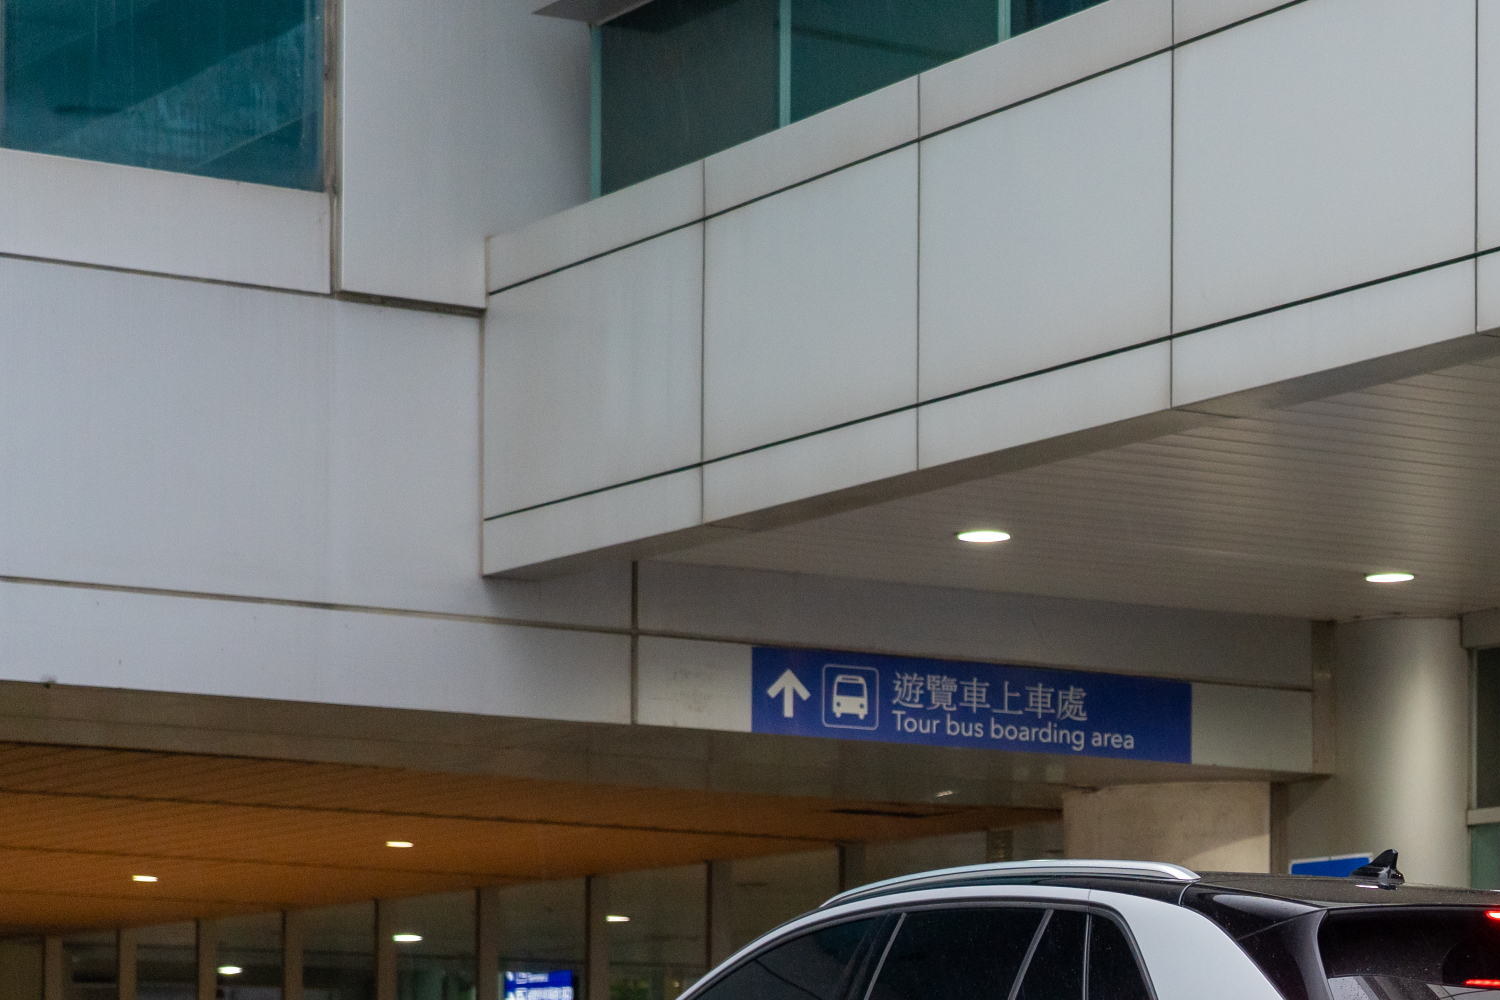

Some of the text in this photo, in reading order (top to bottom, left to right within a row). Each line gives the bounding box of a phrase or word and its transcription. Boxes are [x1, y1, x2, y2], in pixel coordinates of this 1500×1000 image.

[892, 671, 1088, 723] 遊覽車上車處
[892, 710, 1136, 751] Tour bus boarding area
